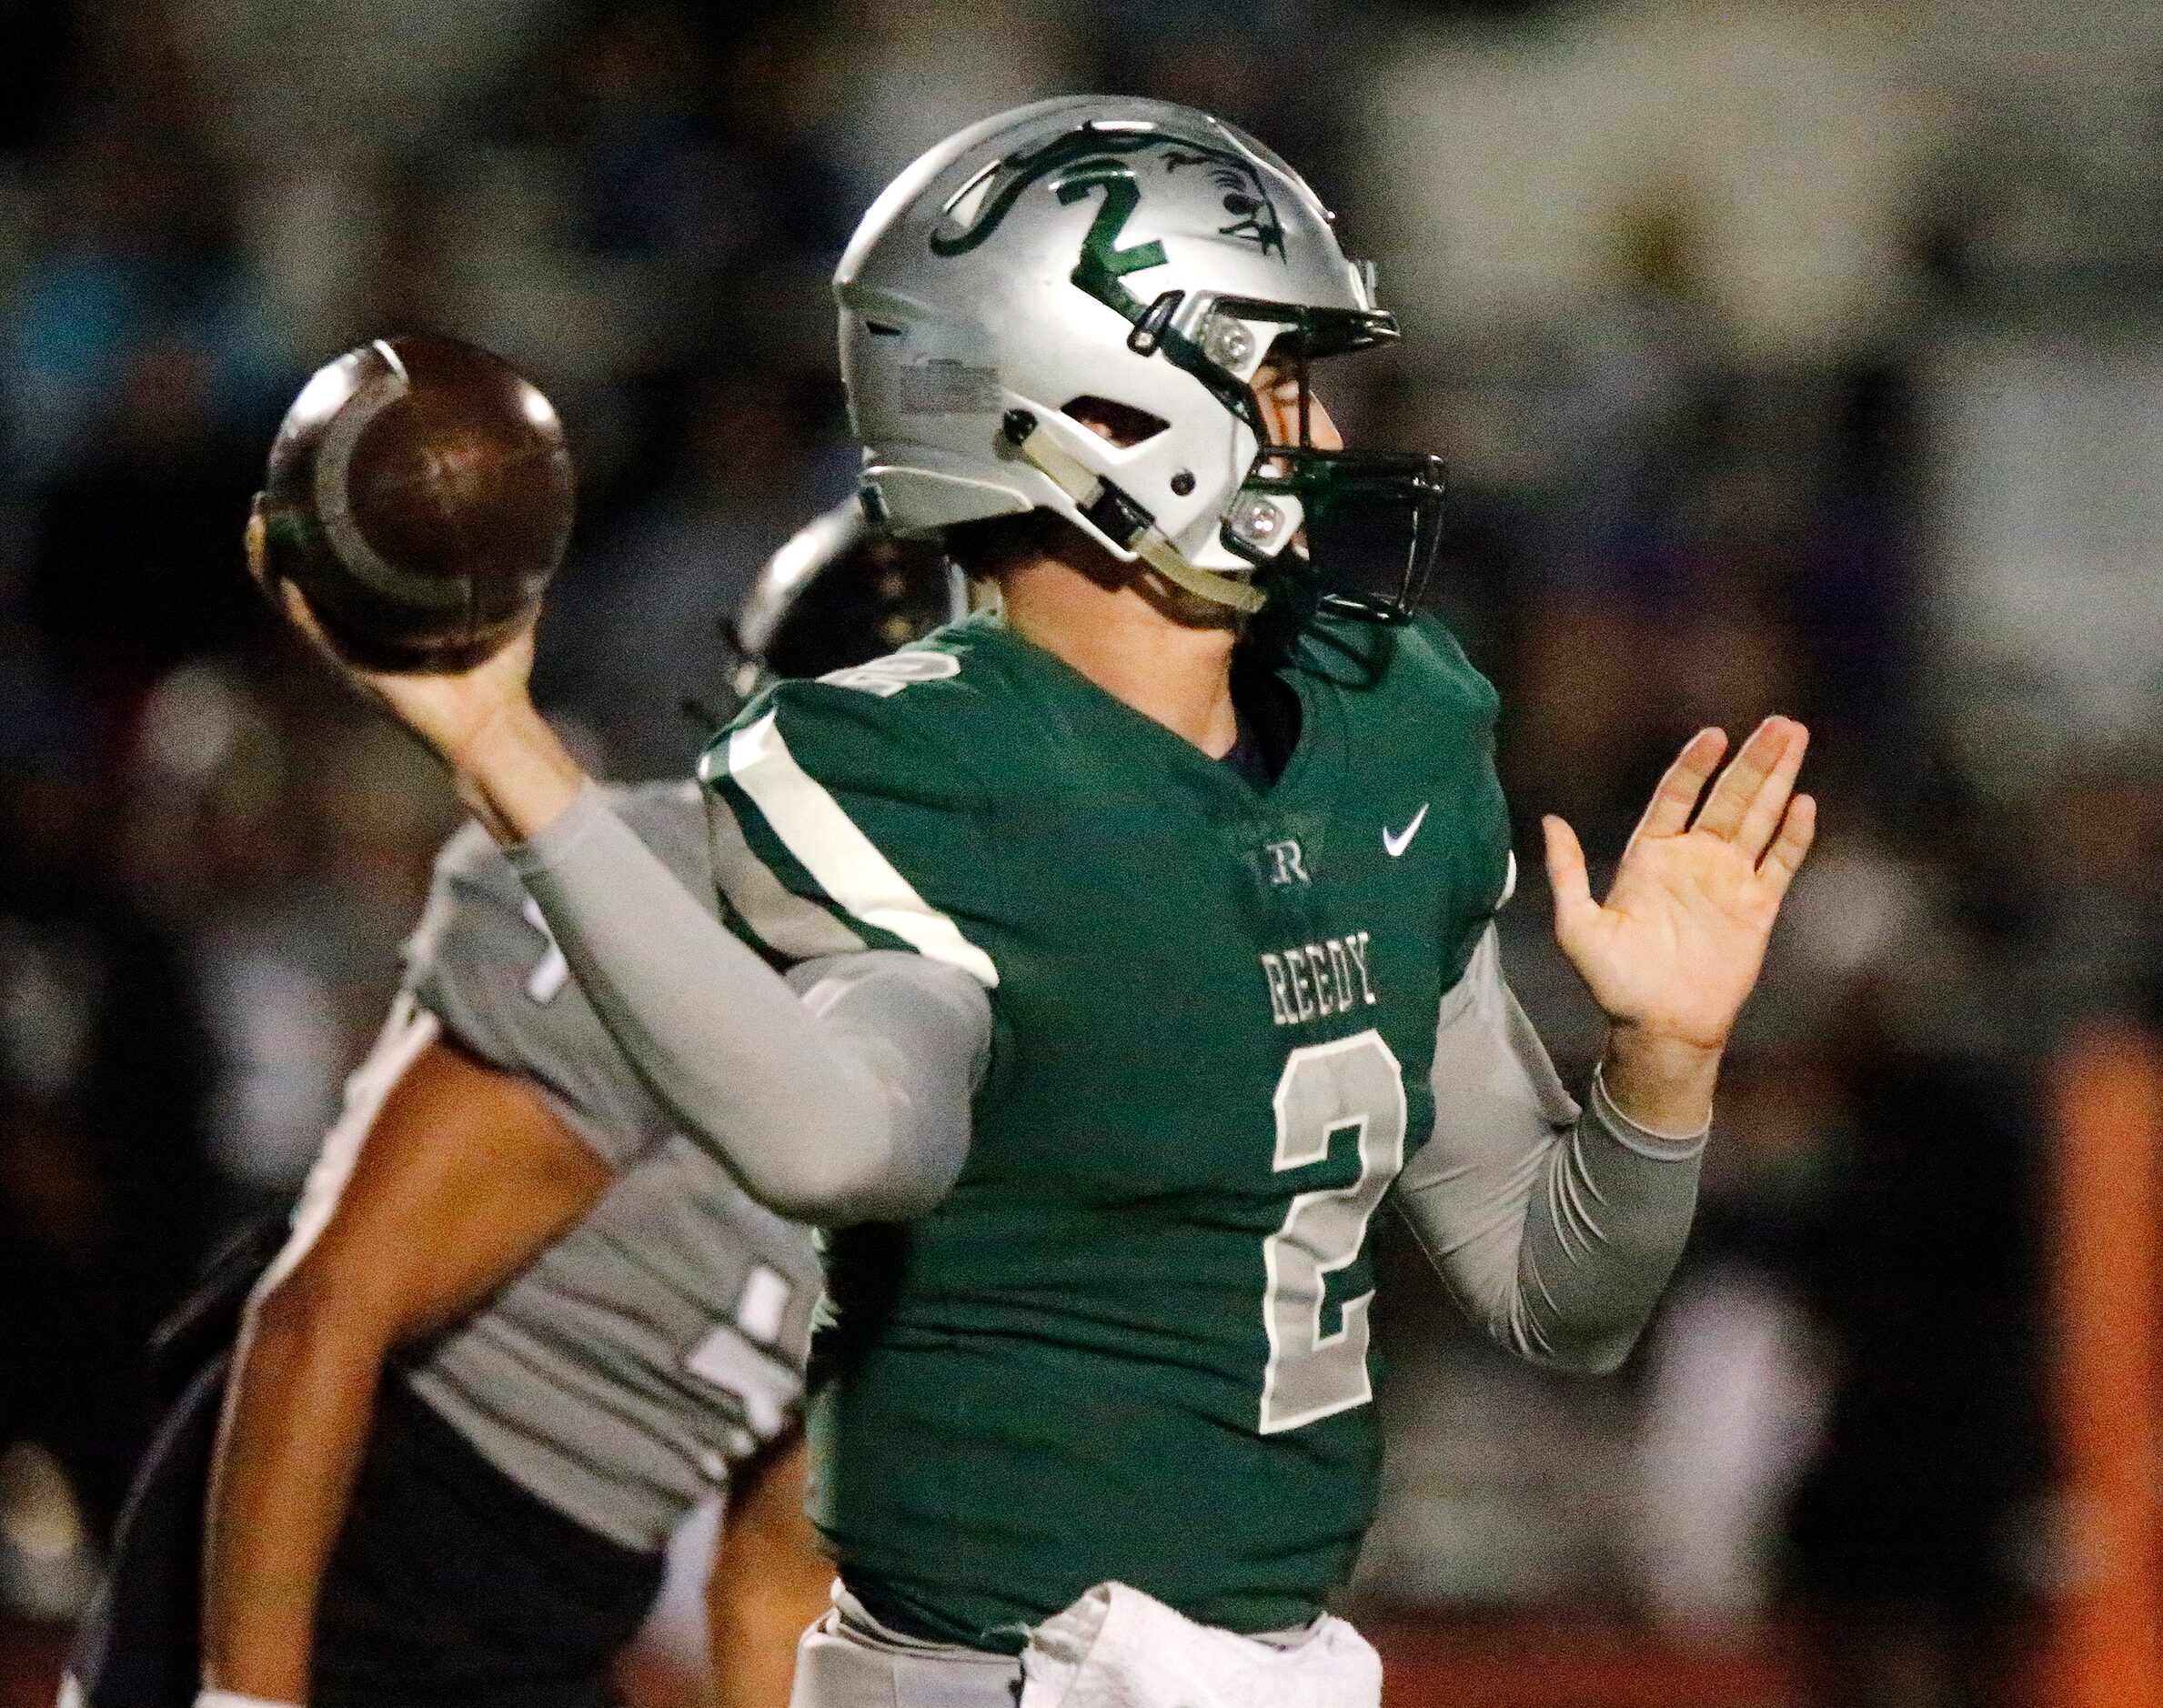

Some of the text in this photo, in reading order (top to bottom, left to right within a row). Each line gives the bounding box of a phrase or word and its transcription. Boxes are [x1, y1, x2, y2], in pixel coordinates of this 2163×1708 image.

[1265, 839, 1312, 888] R
[1261, 931, 1375, 1025] REEDY
[1259, 1029, 1407, 1433] 2
